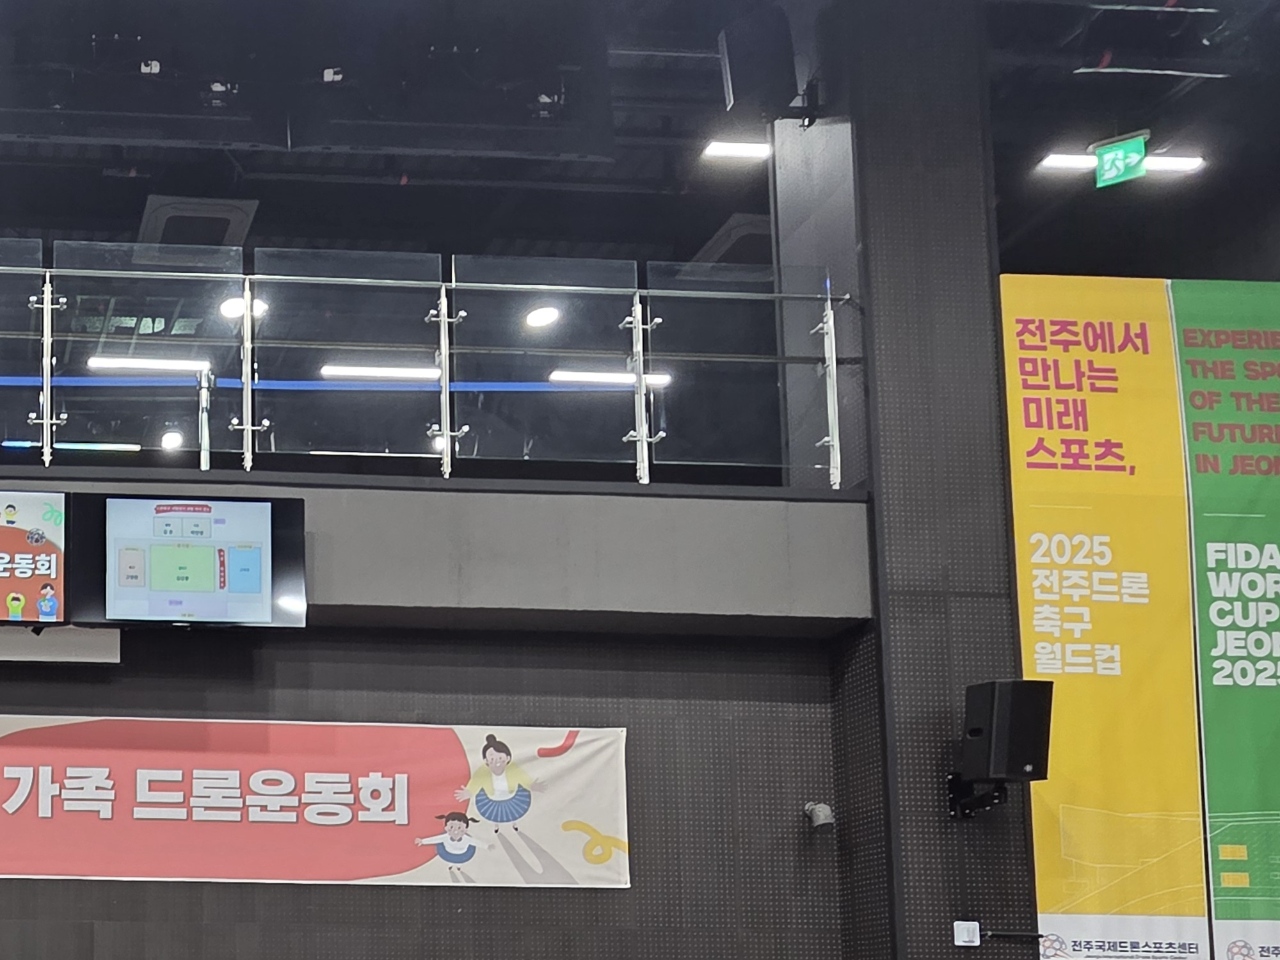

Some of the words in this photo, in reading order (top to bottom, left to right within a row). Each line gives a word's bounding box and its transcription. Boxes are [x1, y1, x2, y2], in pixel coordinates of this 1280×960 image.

[1015, 318, 1150, 355] 전주에서
[1018, 357, 1119, 393] 만나는
[1185, 359, 1236, 380] THE
[1243, 360, 1280, 380] SP
[1022, 396, 1089, 432] 미래
[1189, 390, 1222, 410] OF
[1230, 391, 1280, 412] THE
[1025, 437, 1136, 476] 스포츠,
[1195, 453, 1220, 474] IN
[1029, 532, 1112, 566] 2025
[1206, 542, 1280, 570] FIDA
[1031, 569, 1150, 604] 전주드론
[1032, 605, 1092, 638] 축구
[1209, 600, 1280, 628] CUP
[1034, 642, 1122, 675] 월드컵
[1212, 659, 1280, 686] 202
[1, 765, 116, 819] 가족
[132, 768, 410, 826] 드론운동회
[1071, 940, 1199, 954] 전주국제드론스포츠센터
